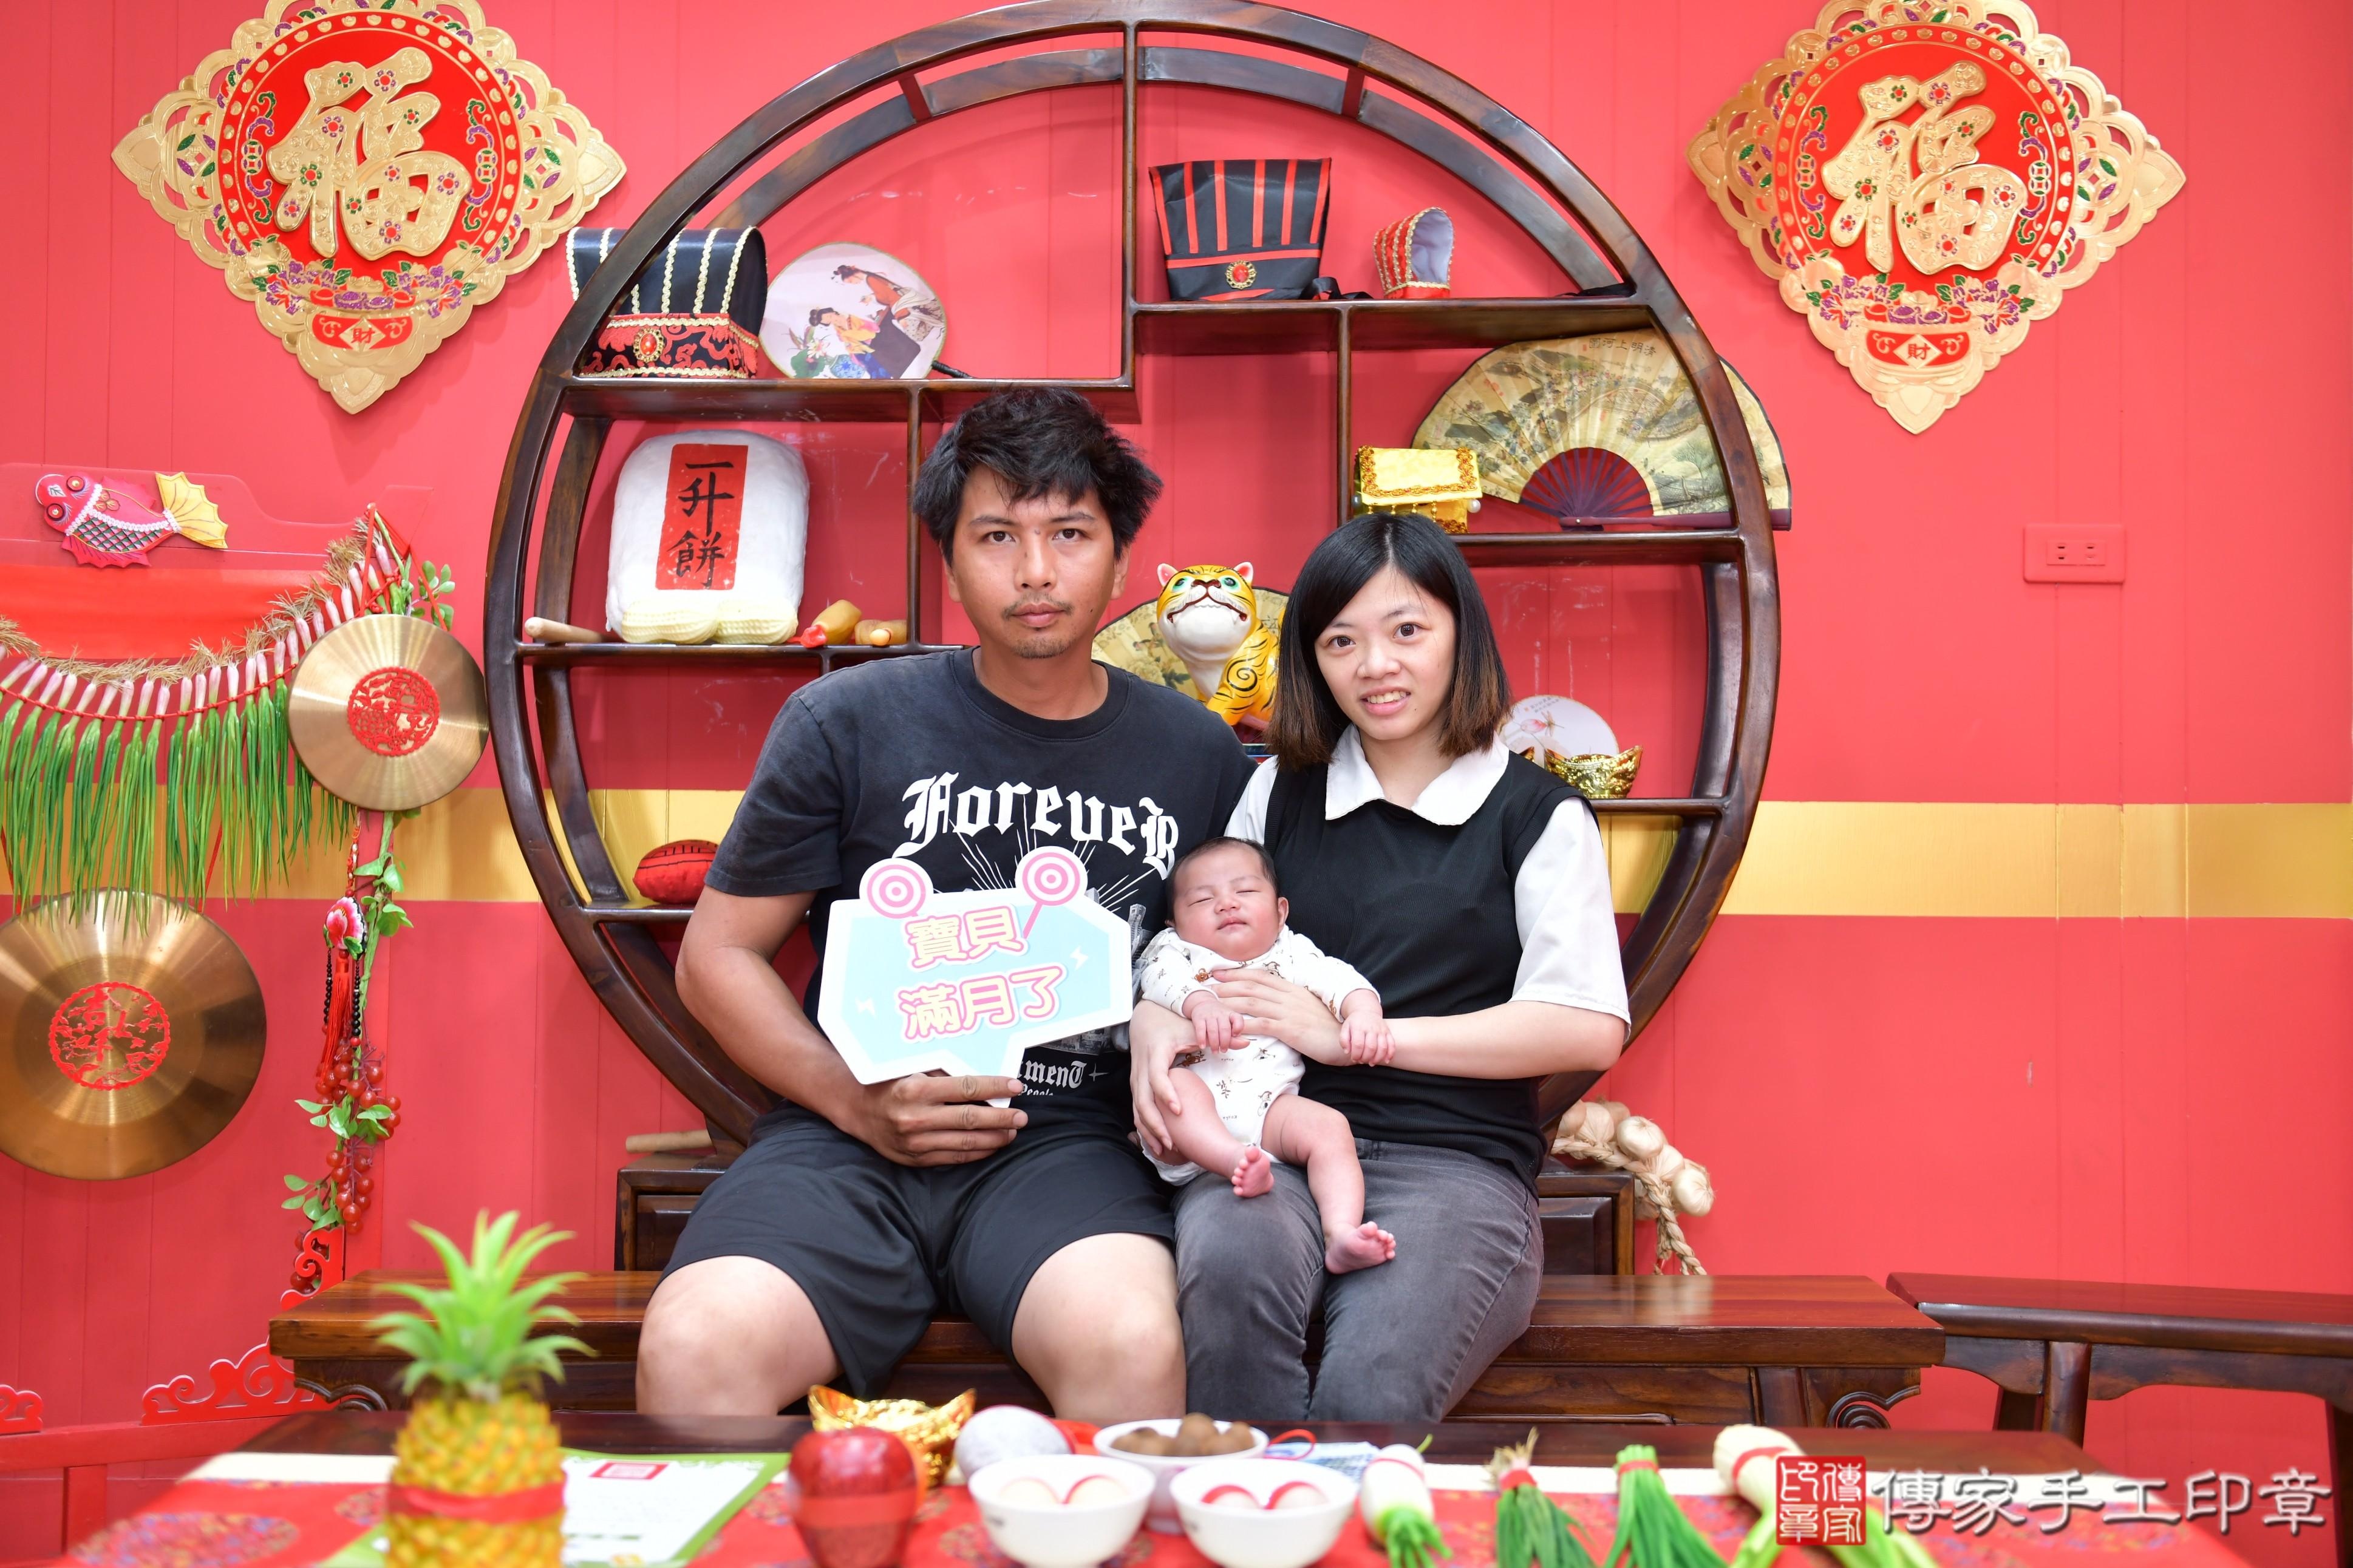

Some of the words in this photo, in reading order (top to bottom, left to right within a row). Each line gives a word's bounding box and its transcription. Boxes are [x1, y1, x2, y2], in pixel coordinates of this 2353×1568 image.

[266, 47, 469, 261] 福
[1822, 60, 2028, 275] 福
[351, 327, 375, 344] 財
[1907, 342, 1931, 360] 財
[667, 461, 735, 589] 一升餅
[904, 905, 1024, 969] 寶貝
[898, 965, 1063, 1040] 滿月了
